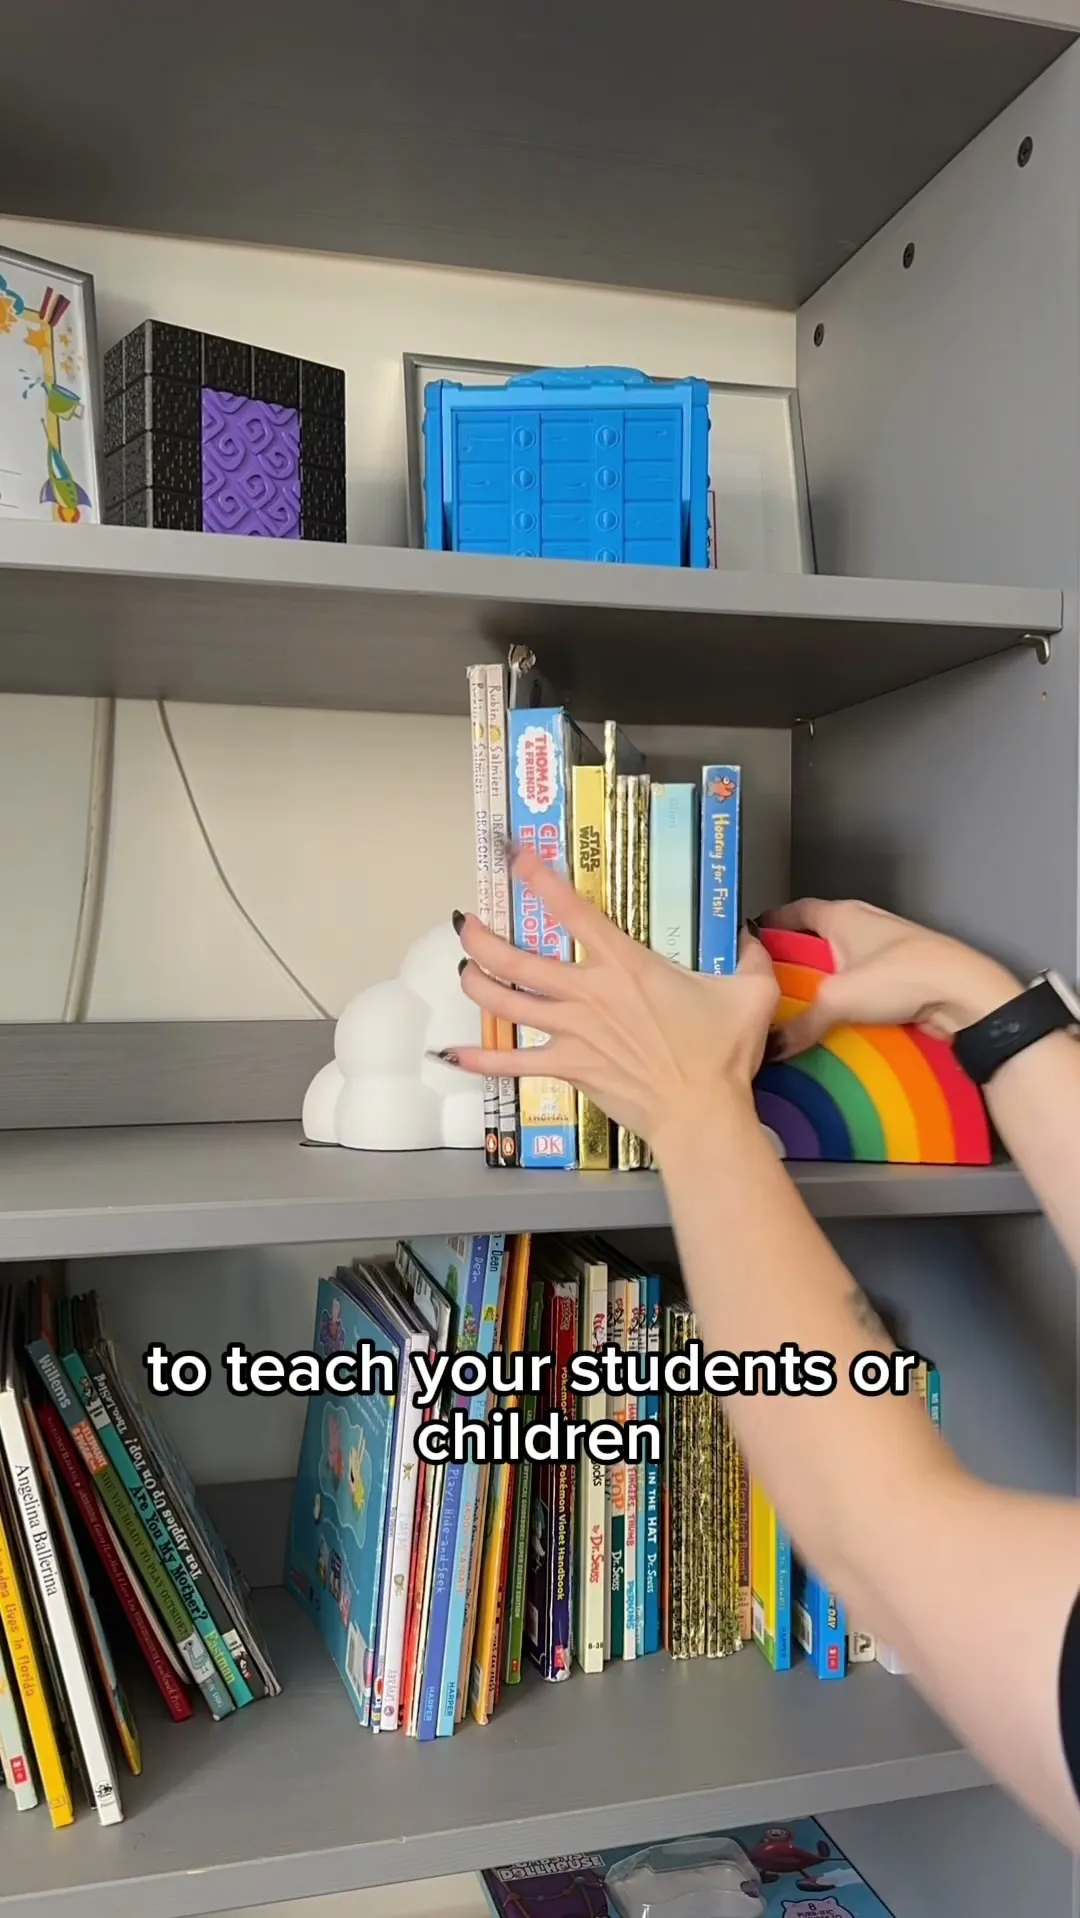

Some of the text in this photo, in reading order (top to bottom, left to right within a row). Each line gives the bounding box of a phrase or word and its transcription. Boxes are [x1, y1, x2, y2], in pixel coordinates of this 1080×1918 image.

[489, 685, 501, 721] Rubin
[491, 746, 503, 797] Salmieri
[525, 740, 535, 800] & FRIENDS
[535, 735, 550, 804] THOMAS
[476, 810, 489, 871] DRAGONS
[492, 814, 504, 874] DRAGONS
[579, 826, 590, 872] WARS
[590, 825, 600, 872] STAR
[479, 880, 491, 916] LOVE
[495, 882, 508, 916] LOVE
[709, 813, 730, 976] Hooray for Fish! Luc
[667, 926, 680, 945] No
[484, 1076, 495, 1094] Dial
[501, 1079, 511, 1097] Dial
[535, 1136, 563, 1155] DK
[471, 1256, 484, 1283] Dean
[489, 1250, 502, 1272] Dean
[37, 1353, 73, 1409] Willems
[627, 1403, 636, 1420] HAN
[124, 1435, 148, 1469] Top!
[141, 1469, 156, 1489] On
[521, 1465, 529, 1498] MYTHICAL
[558, 1464, 568, 1512] Pokémon
[151, 1488, 167, 1508] Up
[15, 1464, 58, 1597] Angelina Ballerina
[160, 1507, 191, 1552] Apples
[557, 1515, 567, 1545] Violet
[590, 1535, 603, 1553] Dr.
[611, 1471, 624, 1592] POP Dr. Seuss
[626, 1513, 636, 1547] THUMB
[647, 1471, 657, 1593] IN THE HAT Dr. Seuss
[183, 1553, 201, 1579] Ten
[517, 1540, 525, 1562] SUPER
[129, 1482, 239, 1684] Are You My Mother? Eastman
[516, 1564, 524, 1589] DELUXE
[556, 1547, 566, 1601] Handbook
[589, 1554, 604, 1584] Seuss
[425, 1468, 460, 1721] Plays Hide-and-Seek HARPER
[514, 1590, 522, 1618] EDITION
[626, 1580, 635, 1630] PERKINS
[826, 1608, 838, 1630] DAY
[446, 1681, 455, 1717] HARPER
[501, 1856, 603, 1881] DOLLHOUSE
